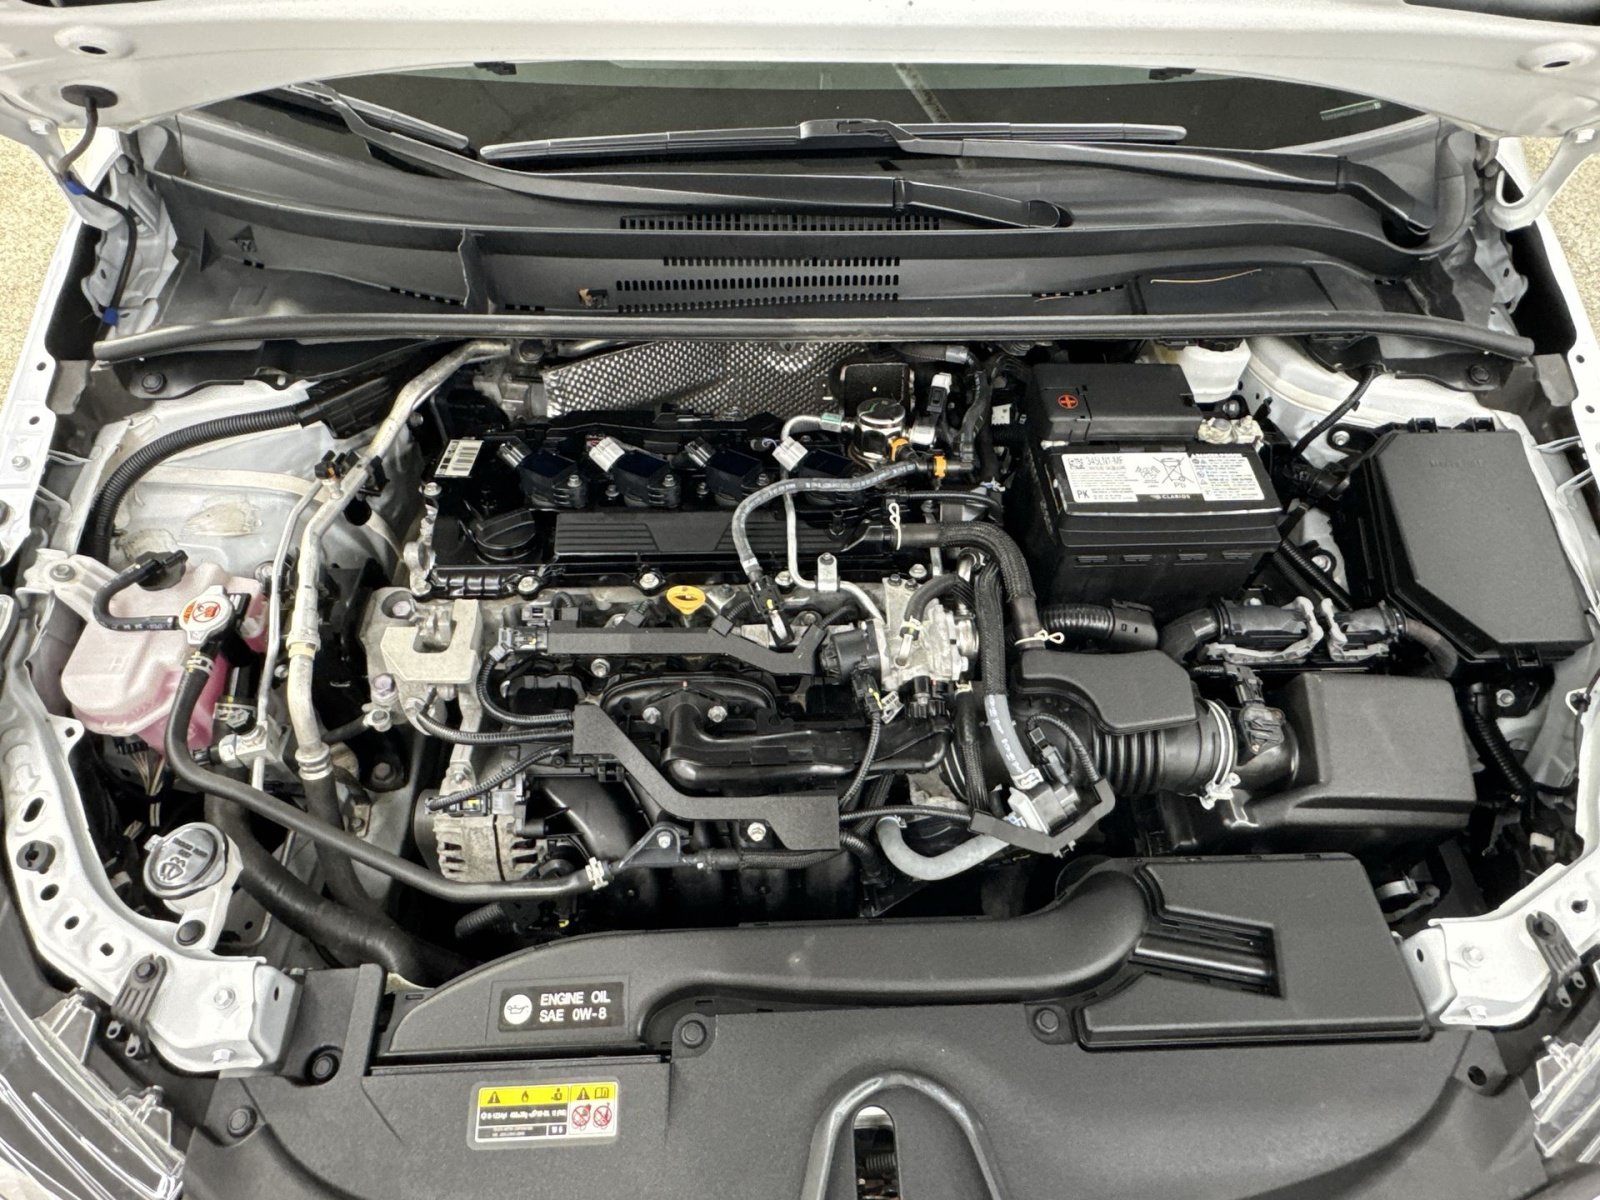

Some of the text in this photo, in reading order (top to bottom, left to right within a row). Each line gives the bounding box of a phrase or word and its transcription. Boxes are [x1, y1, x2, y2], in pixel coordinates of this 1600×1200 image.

[1077, 490, 1090, 499] PK
[540, 991, 611, 1006] ENGINE OIL
[540, 1007, 606, 1022] SAE 0W-8
